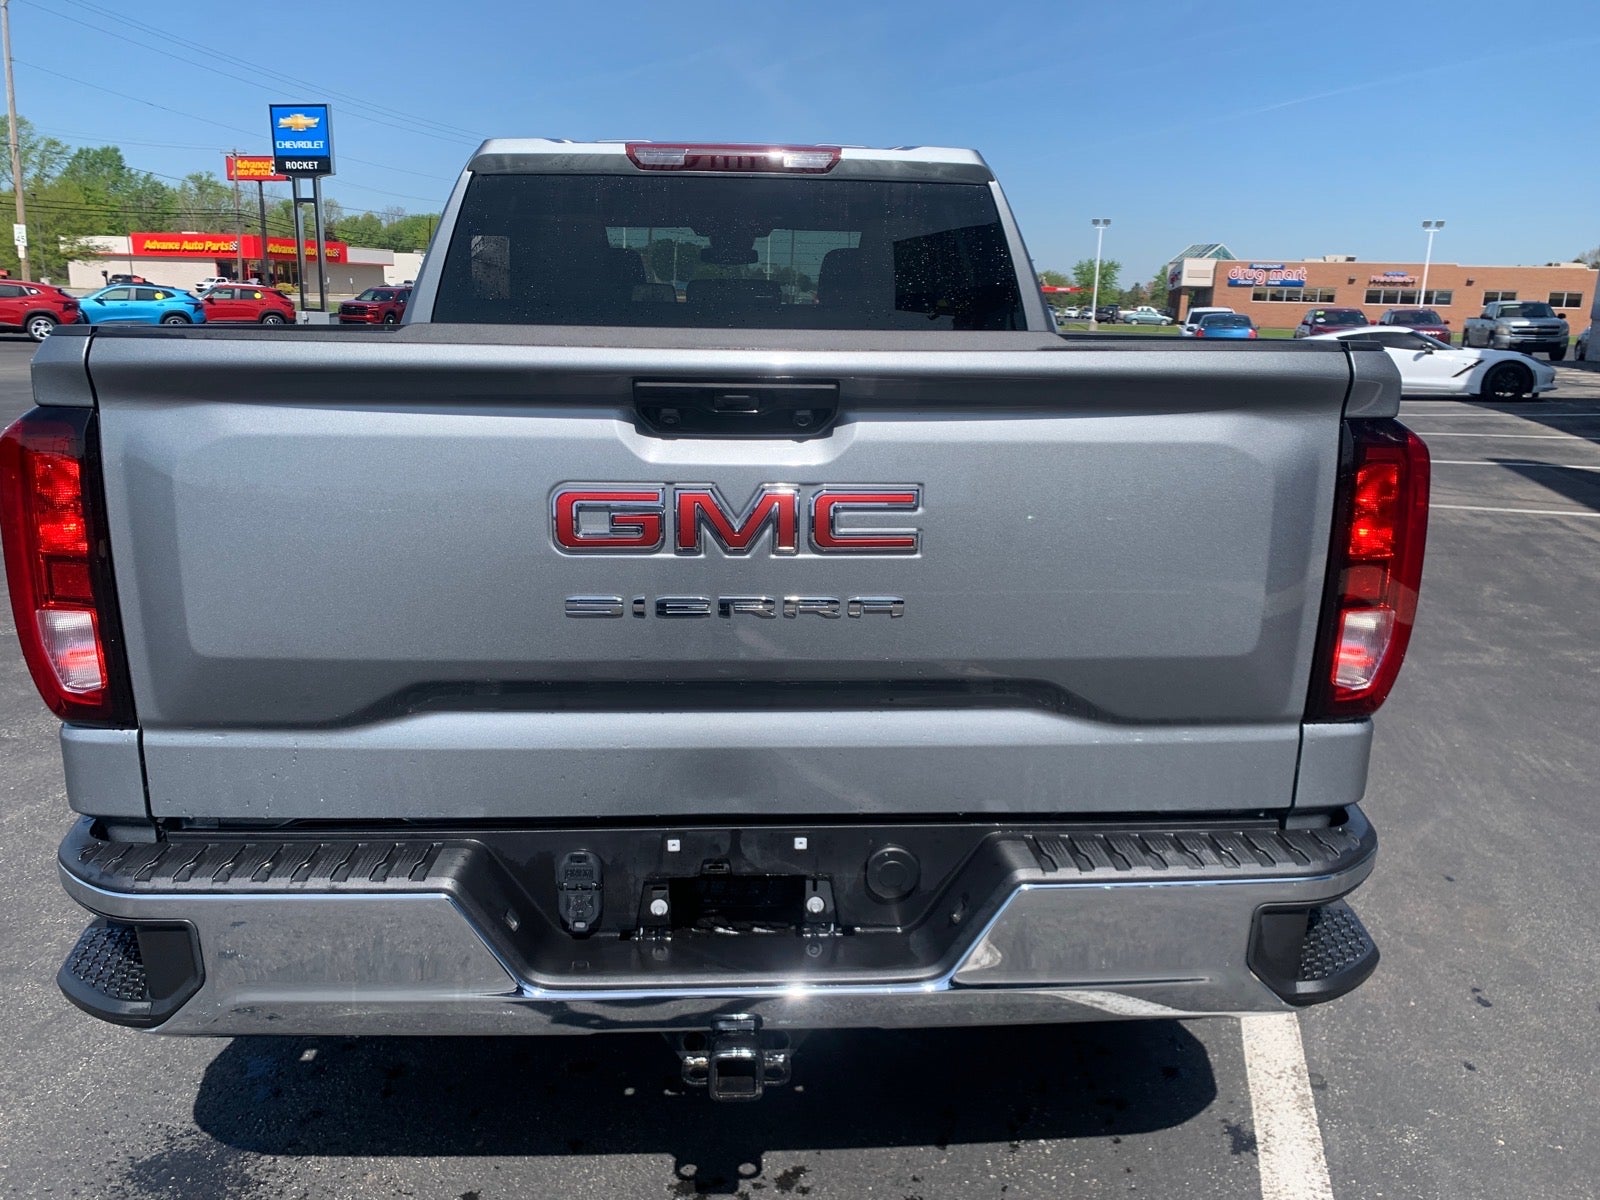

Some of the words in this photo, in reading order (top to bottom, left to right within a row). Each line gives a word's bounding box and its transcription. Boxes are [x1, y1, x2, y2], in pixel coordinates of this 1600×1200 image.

[276, 140, 325, 149] CHEVROLET
[236, 160, 269, 168] Advance
[285, 161, 319, 170] ROCKET
[144, 240, 180, 250] Advance
[181, 241, 204, 250] Auto
[204, 241, 230, 251] Parts
[1228, 266, 1266, 285] drug
[1269, 266, 1307, 281] mart
[550, 484, 921, 556] GMC
[565, 594, 905, 618] SIERRA
